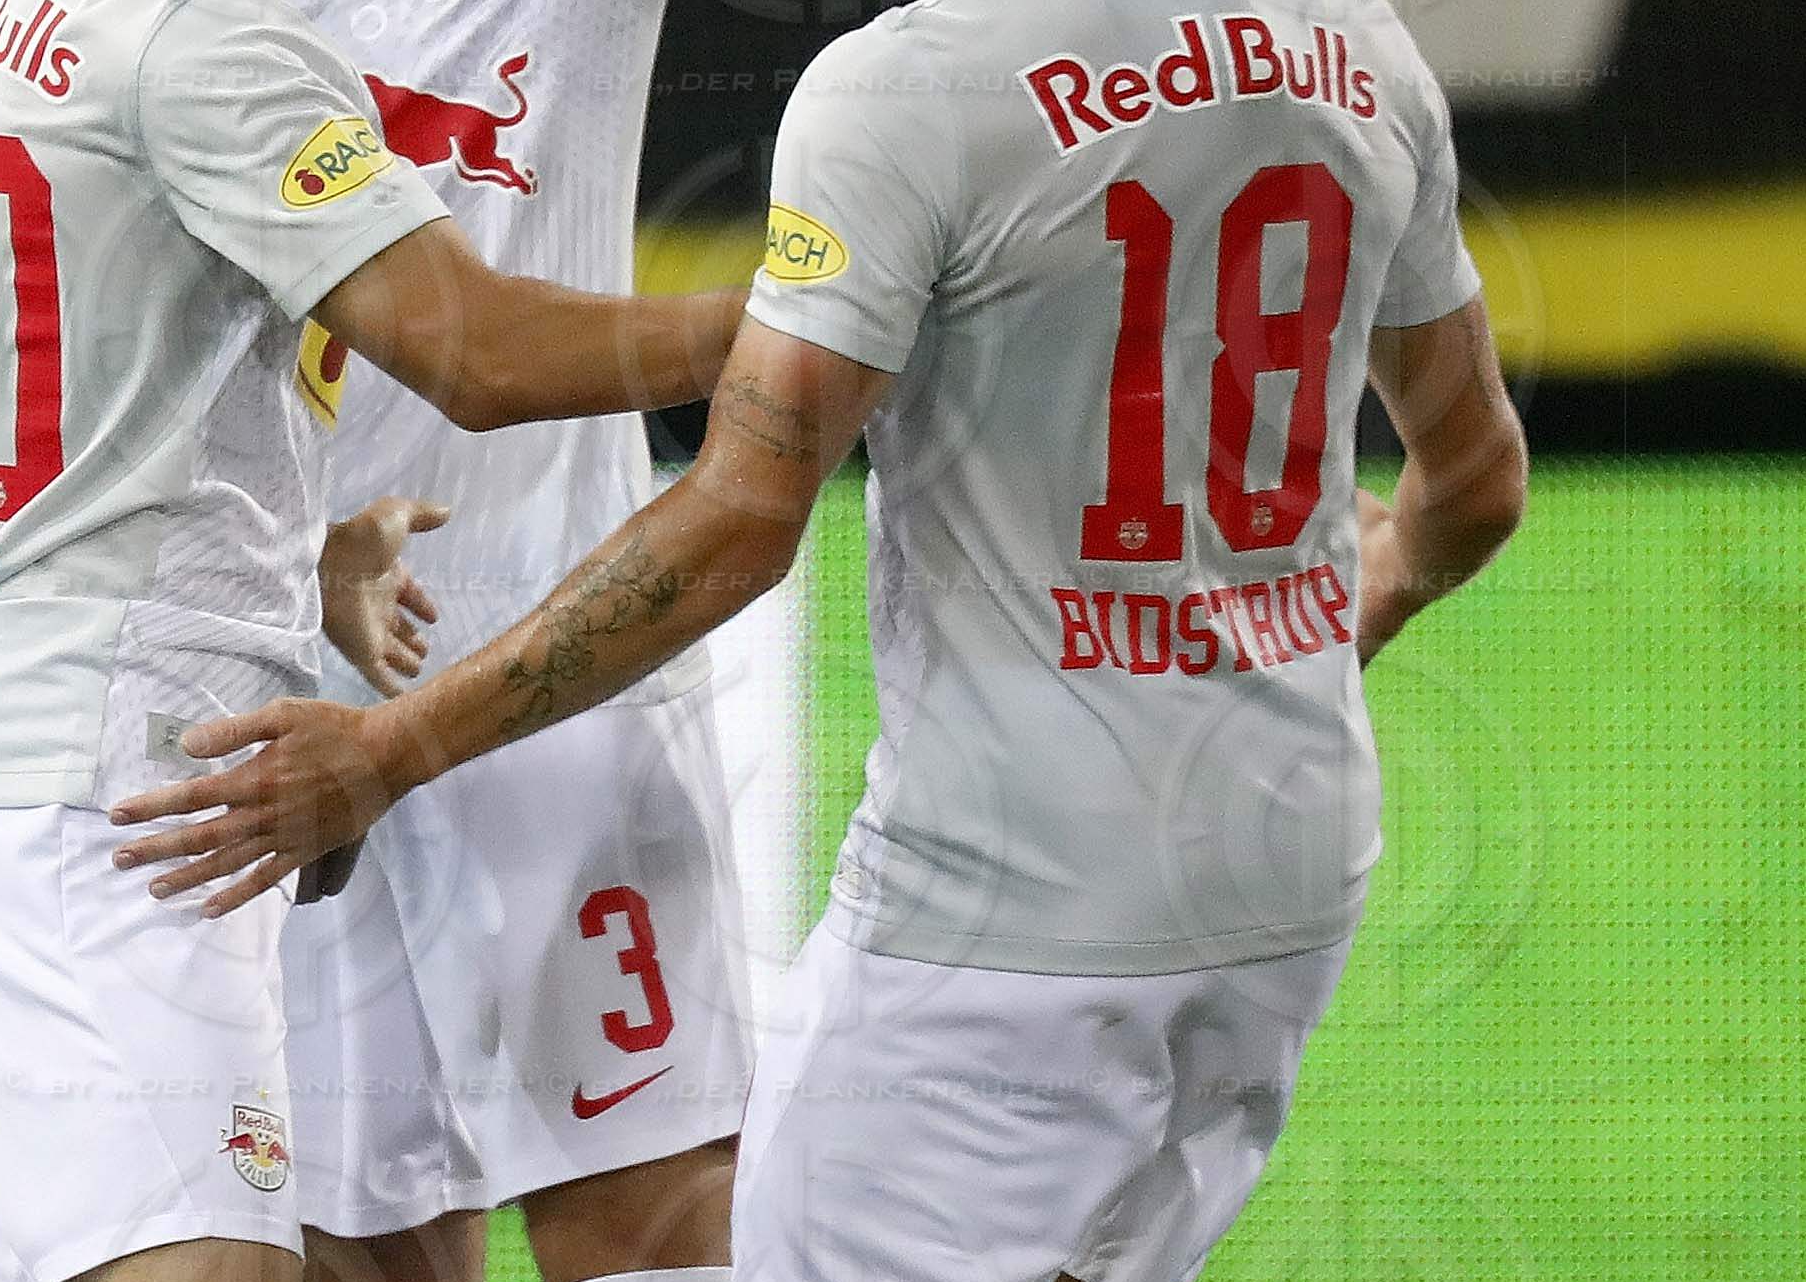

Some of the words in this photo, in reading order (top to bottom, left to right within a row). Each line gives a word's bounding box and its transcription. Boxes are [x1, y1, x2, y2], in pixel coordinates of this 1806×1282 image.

[1029, 16, 1214, 150] Red
[1224, 17, 1378, 121] Bulls
[1080, 161, 1354, 564] 18
[1050, 563, 1354, 676] BIDSTRUP
[577, 884, 675, 1053] 3
